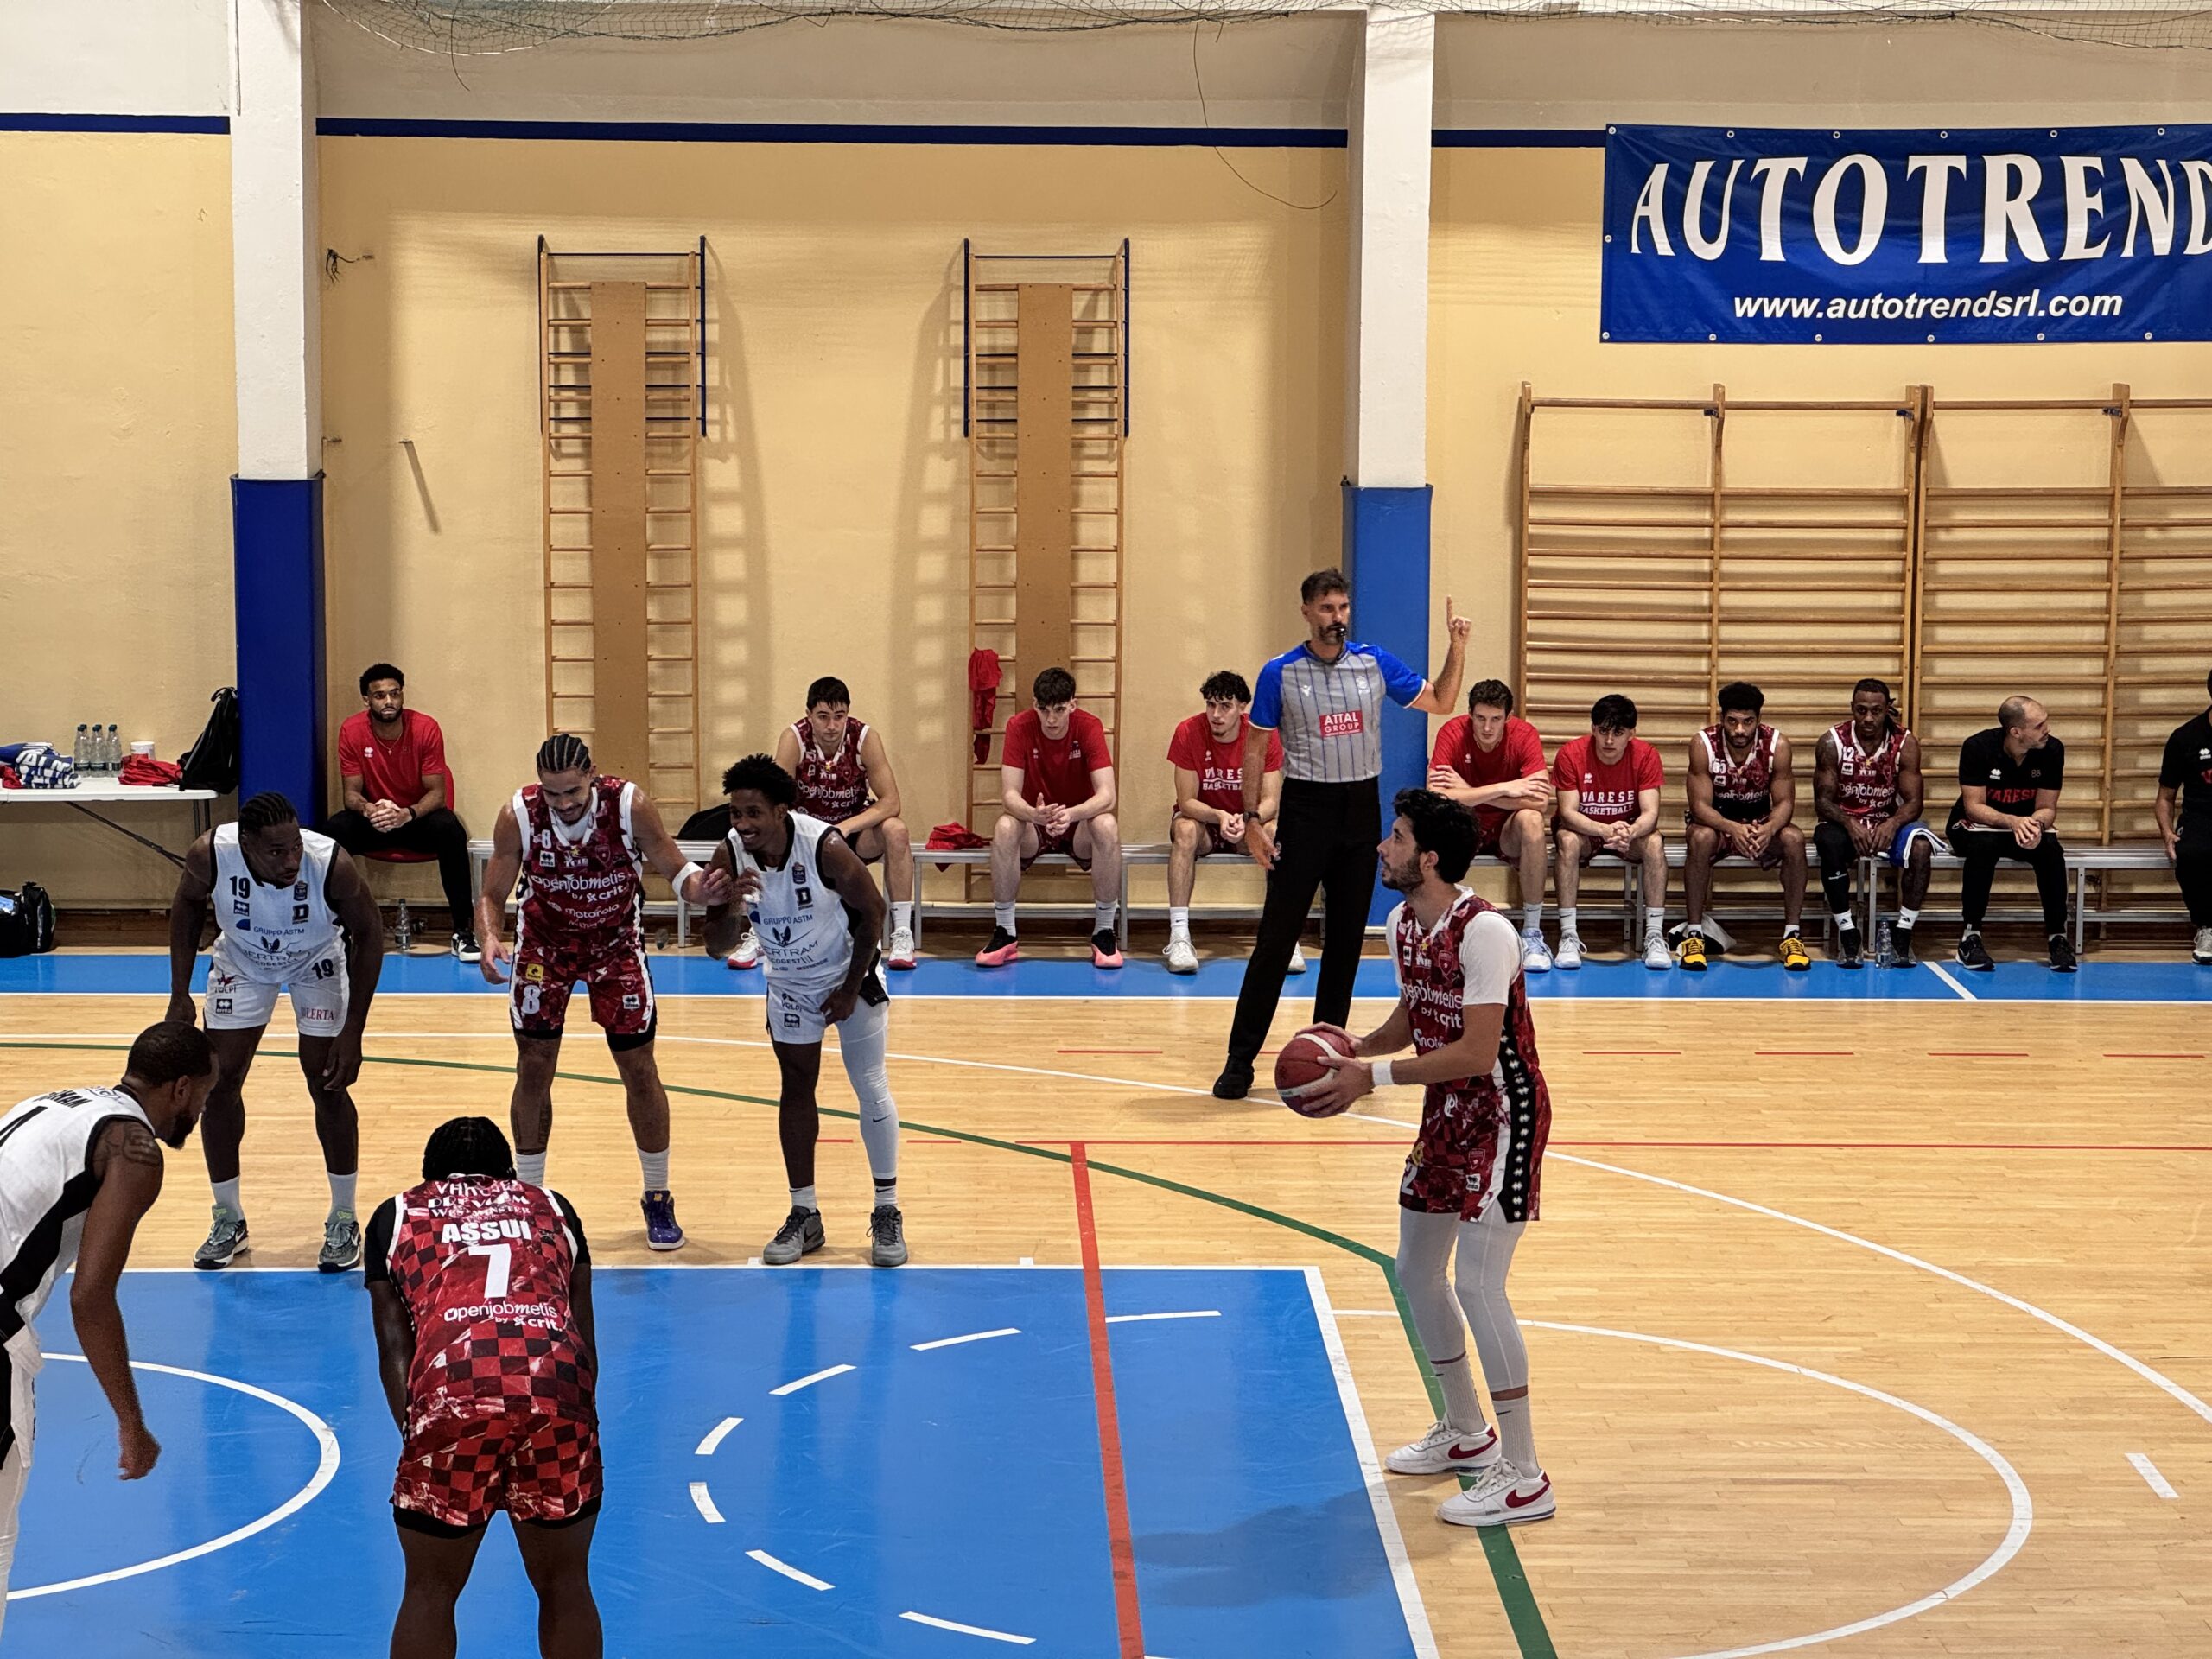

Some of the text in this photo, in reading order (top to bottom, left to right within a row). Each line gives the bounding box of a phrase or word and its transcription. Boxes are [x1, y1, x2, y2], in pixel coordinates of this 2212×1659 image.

[1630, 154, 2212, 266] AUTOTREND
[1733, 289, 2123, 320] www.autotrendsrl.com
[1324, 711, 1358, 726] ATTAL
[1324, 722, 1359, 733] GROUP
[1582, 790, 1635, 804] VARESE
[541, 830, 552, 849] 8
[229, 874, 251, 899] 19
[763, 914, 814, 925] GRUPPO ASTM
[253, 926, 283, 937] GRUPPO
[311, 958, 334, 980] 19
[521, 984, 541, 1014] 8
[1401, 1161, 1418, 1196] 2
[441, 1218, 532, 1243] ASSUI
[467, 1243, 512, 1298] 7
[443, 1300, 558, 1322] Openjobmetis
